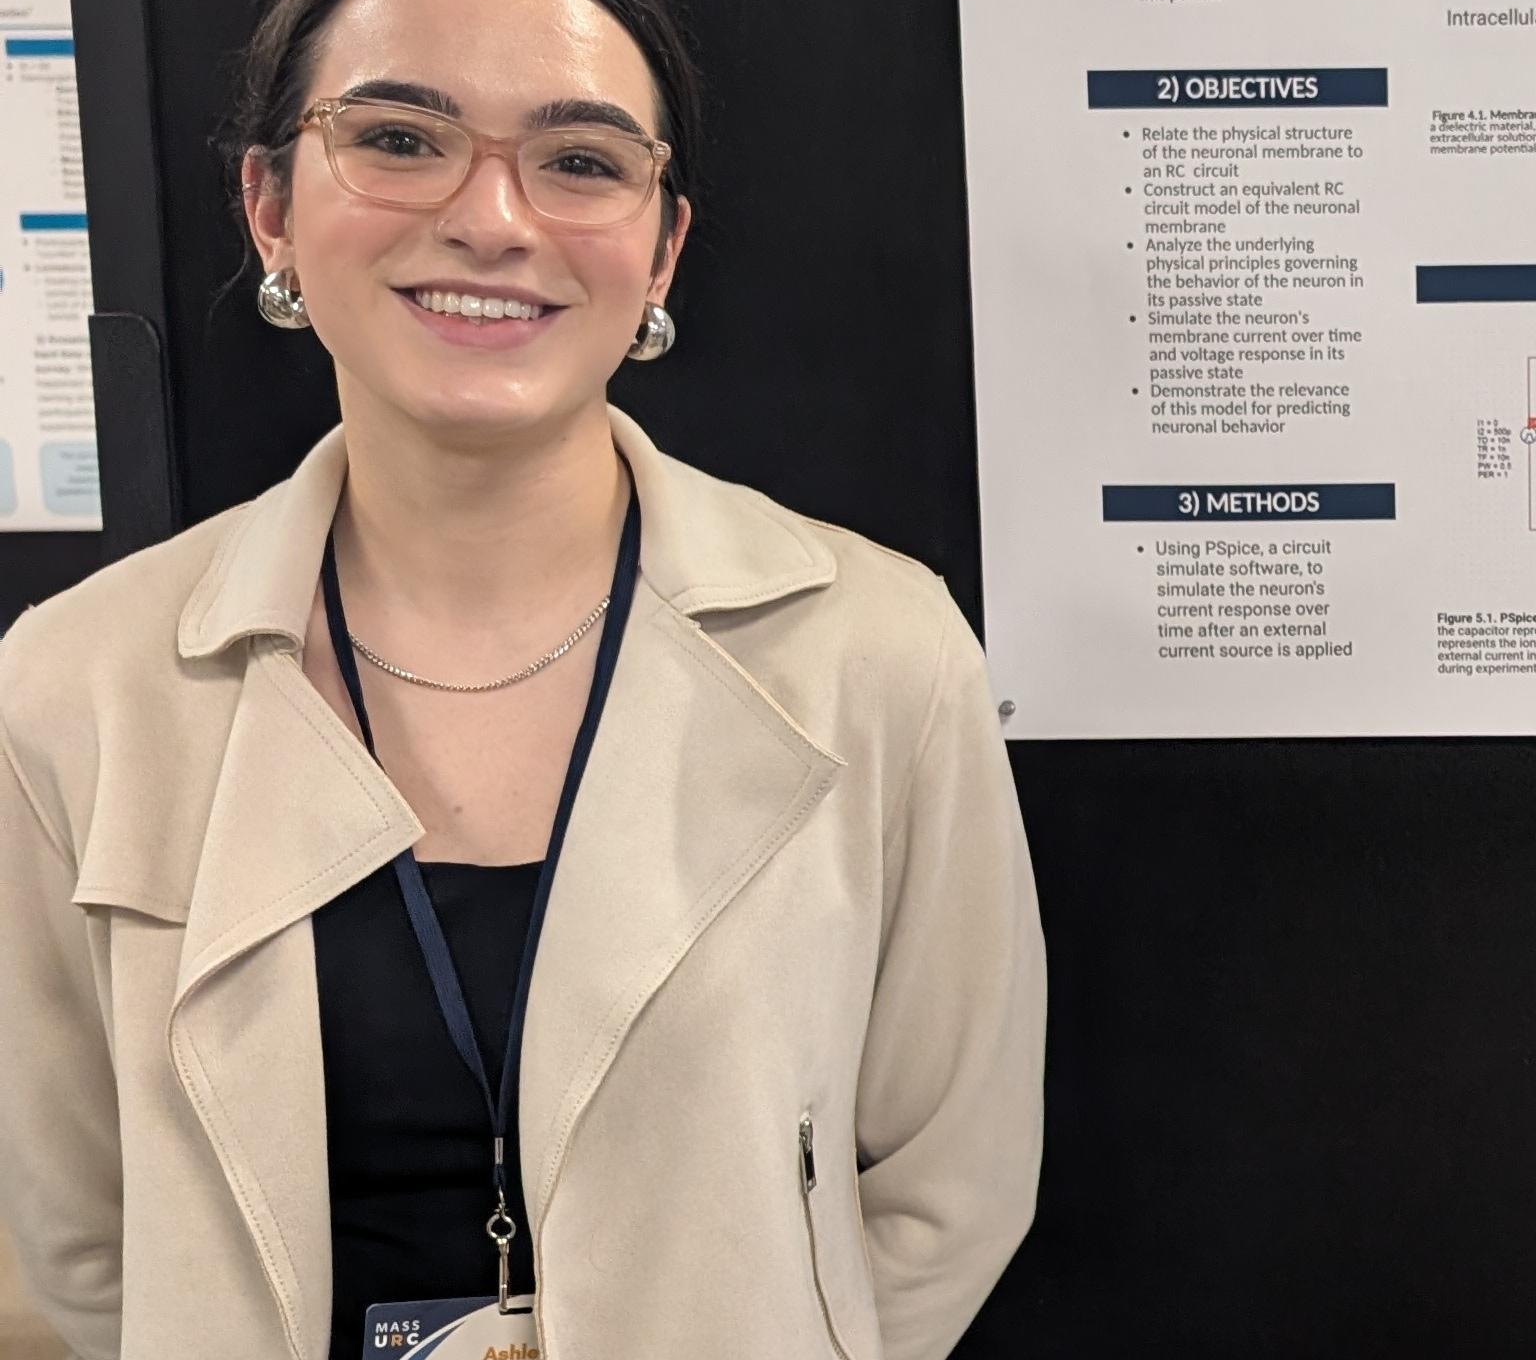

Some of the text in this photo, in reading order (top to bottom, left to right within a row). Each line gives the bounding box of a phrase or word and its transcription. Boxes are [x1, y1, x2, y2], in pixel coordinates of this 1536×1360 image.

[1158, 76, 1318, 102] 2) OBJECTIVES
[1143, 126, 1352, 143] Relate the physical structure
[1143, 144, 1363, 159] of the neuronal membrane to
[1144, 163, 1239, 177] an RC circuit
[1178, 492, 1320, 517] 3) METHODS
[1156, 540, 1331, 559] Using PSpice, a circuit
[1157, 560, 1322, 576] simulate software, to
[375, 1320, 420, 1333] MASS
[375, 1333, 419, 1348] URC
